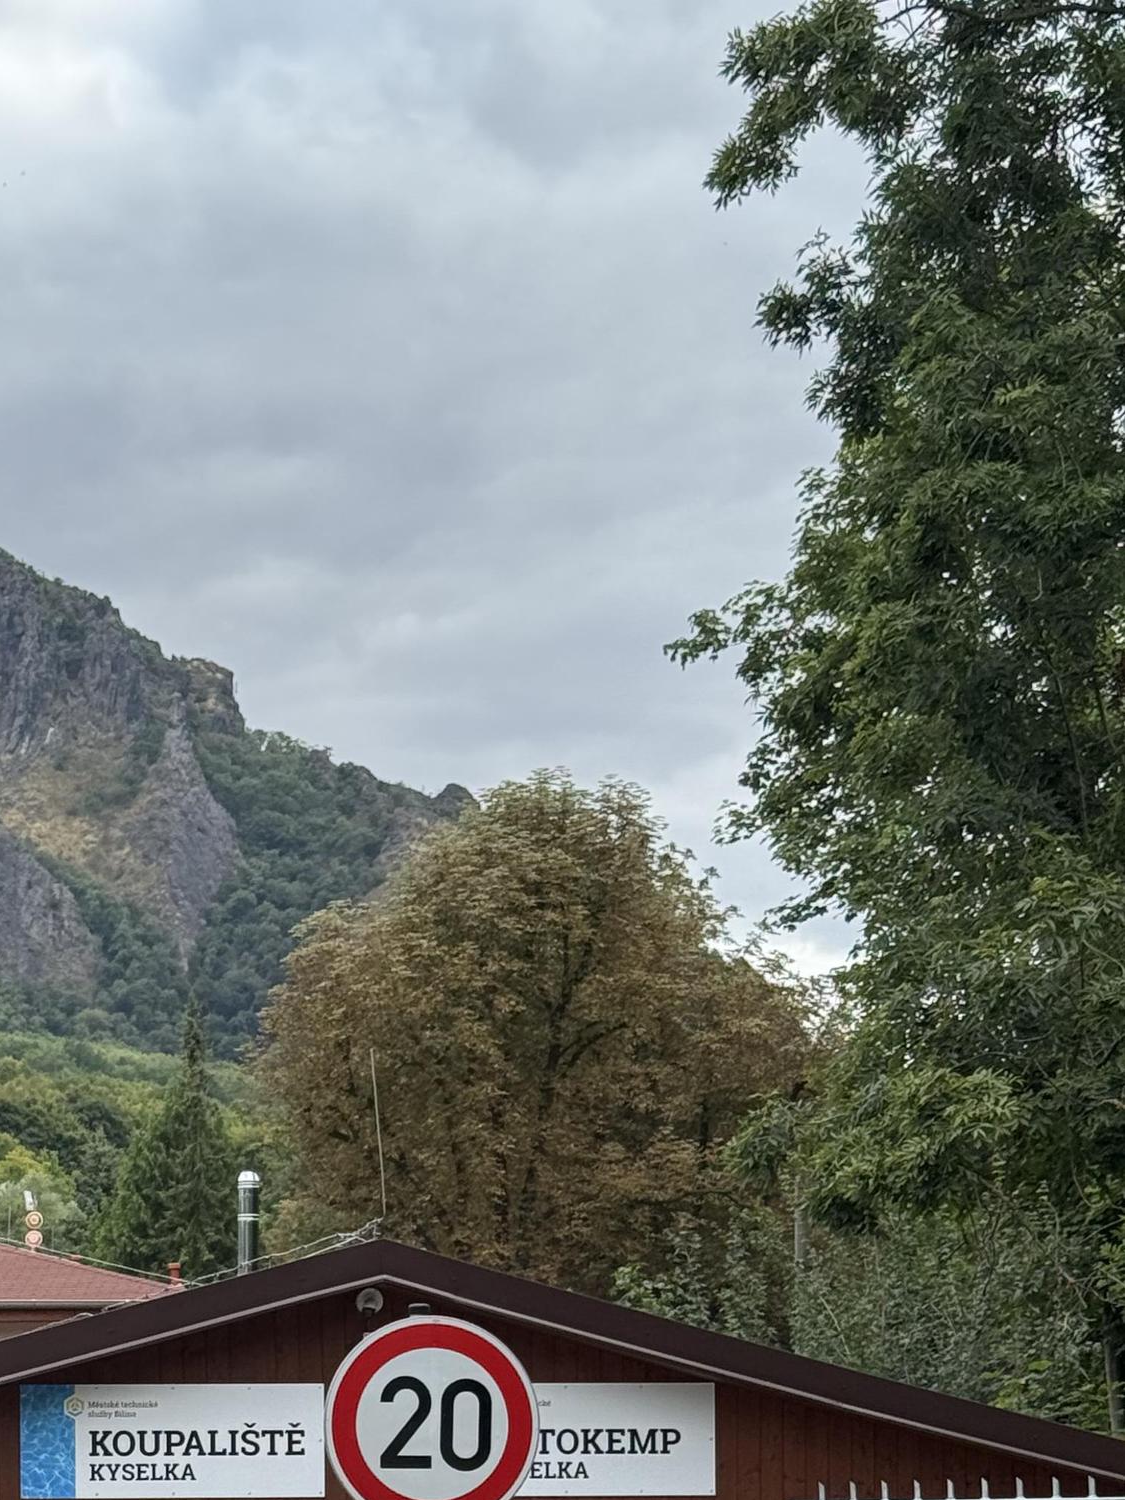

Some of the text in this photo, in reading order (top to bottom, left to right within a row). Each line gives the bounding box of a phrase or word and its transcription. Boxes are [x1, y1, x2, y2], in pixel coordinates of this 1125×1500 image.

[380, 1375, 492, 1472] 20
[88, 1422, 306, 1457] KOUPALIŠTĚ
[538, 1427, 682, 1455] TOKEMP
[88, 1463, 197, 1482] KYSELKA
[529, 1461, 590, 1479] ELKA
